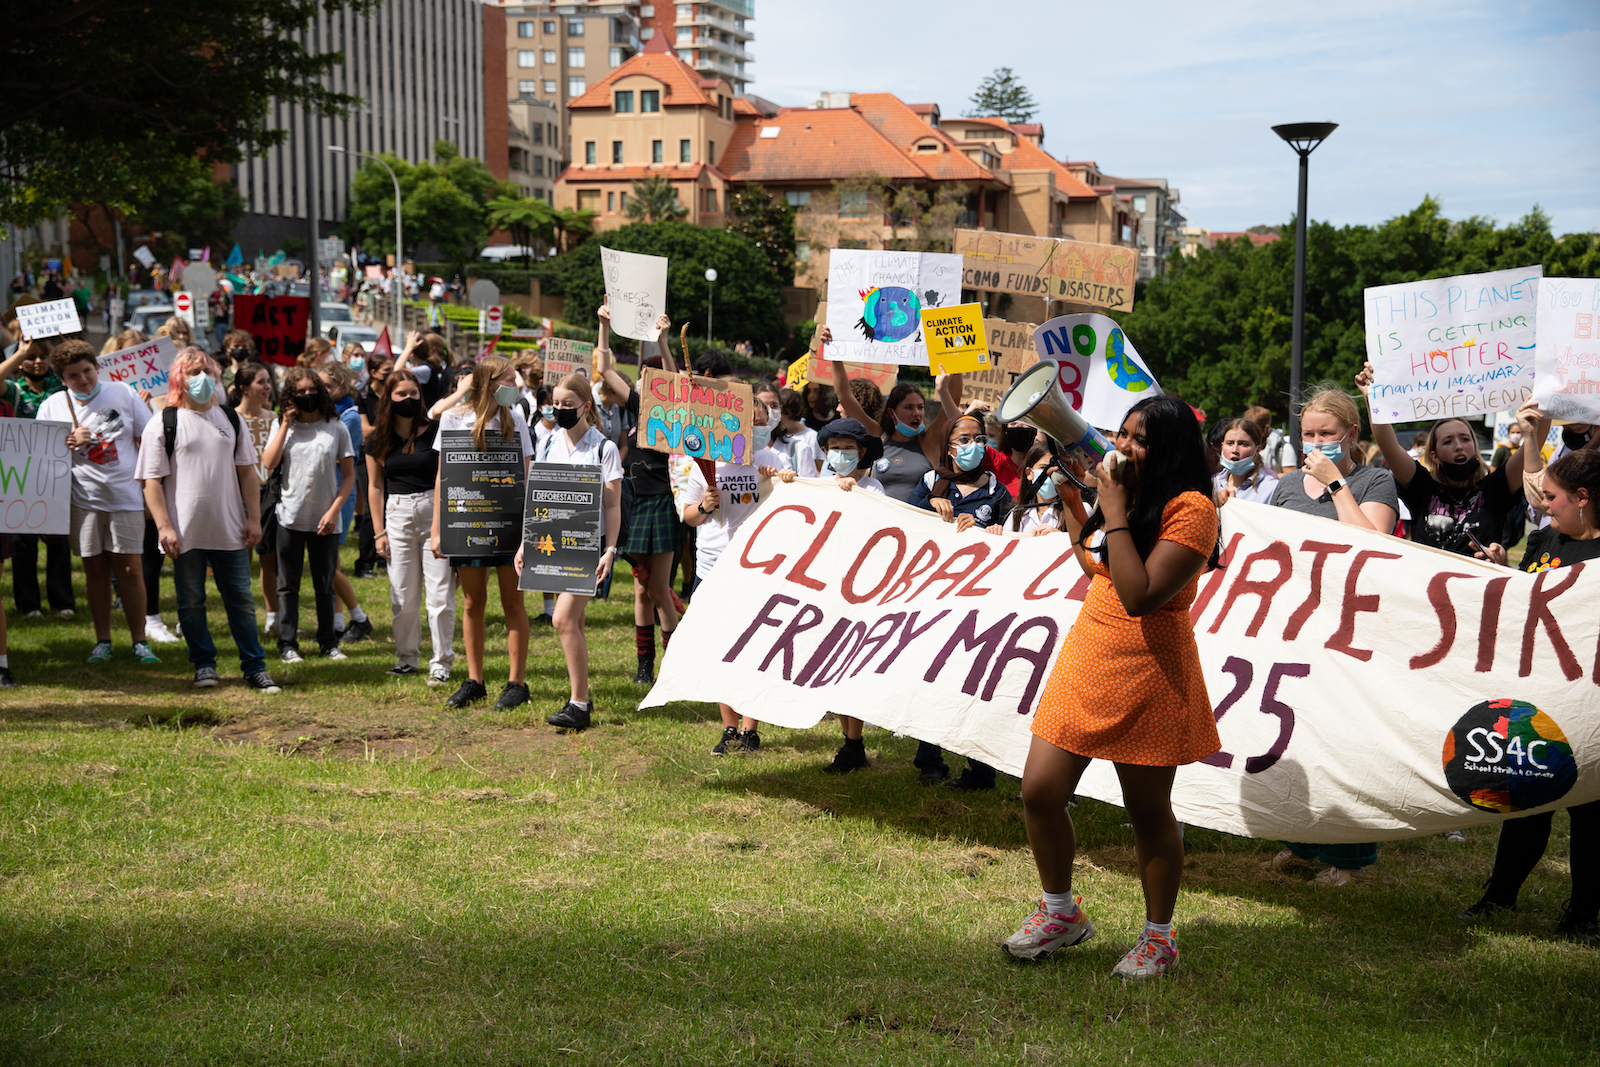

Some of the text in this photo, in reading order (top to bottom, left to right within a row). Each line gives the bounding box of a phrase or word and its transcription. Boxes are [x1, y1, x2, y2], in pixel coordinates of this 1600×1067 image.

[834, 255, 947, 281] THE CLIMATE IS
[1006, 273, 1049, 294] FUNDS
[1059, 279, 1125, 306] DISASTERS
[20, 302, 70, 316] CLIMATE
[1369, 277, 1540, 326] THIS PLANET
[27, 313, 72, 326] ACTION
[252, 303, 297, 326] ACT
[926, 317, 964, 329] CLIMATE
[38, 326, 60, 336] NOW
[935, 324, 974, 337] ACTION
[1378, 316, 1528, 356] IS GETTING
[549, 339, 594, 356] THIS PLANET
[944, 334, 976, 348] NOW
[991, 330, 1039, 352] PLANE
[1042, 324, 1097, 357] NO
[138, 344, 160, 358] DATE
[548, 352, 584, 364] IS GETTING
[828, 341, 847, 357] SO
[853, 342, 879, 358] WHY
[547, 362, 572, 373] HOTTER
[1410, 342, 1514, 376] HOTTER
[109, 364, 137, 382] NOT
[1418, 380, 1438, 392] MY
[1448, 364, 1526, 389] IMAGINARY
[1409, 386, 1532, 420] BOYFRIEND
[42, 424, 71, 459] TO
[36, 458, 70, 498] UP
[716, 475, 755, 483] CLIMATE
[722, 482, 759, 491] ACTIO
[536, 492, 588, 502] DEFORESTATION
[534, 507, 548, 518] 1-2
[561, 536, 577, 546] 91%
[740, 504, 1019, 606] GLOBAL
[1023, 533, 1402, 663] CATE
[721, 593, 1311, 774] FRIDAY MA 25
[1465, 727, 1548, 770] SS4C
[1464, 761, 1492, 772] School
